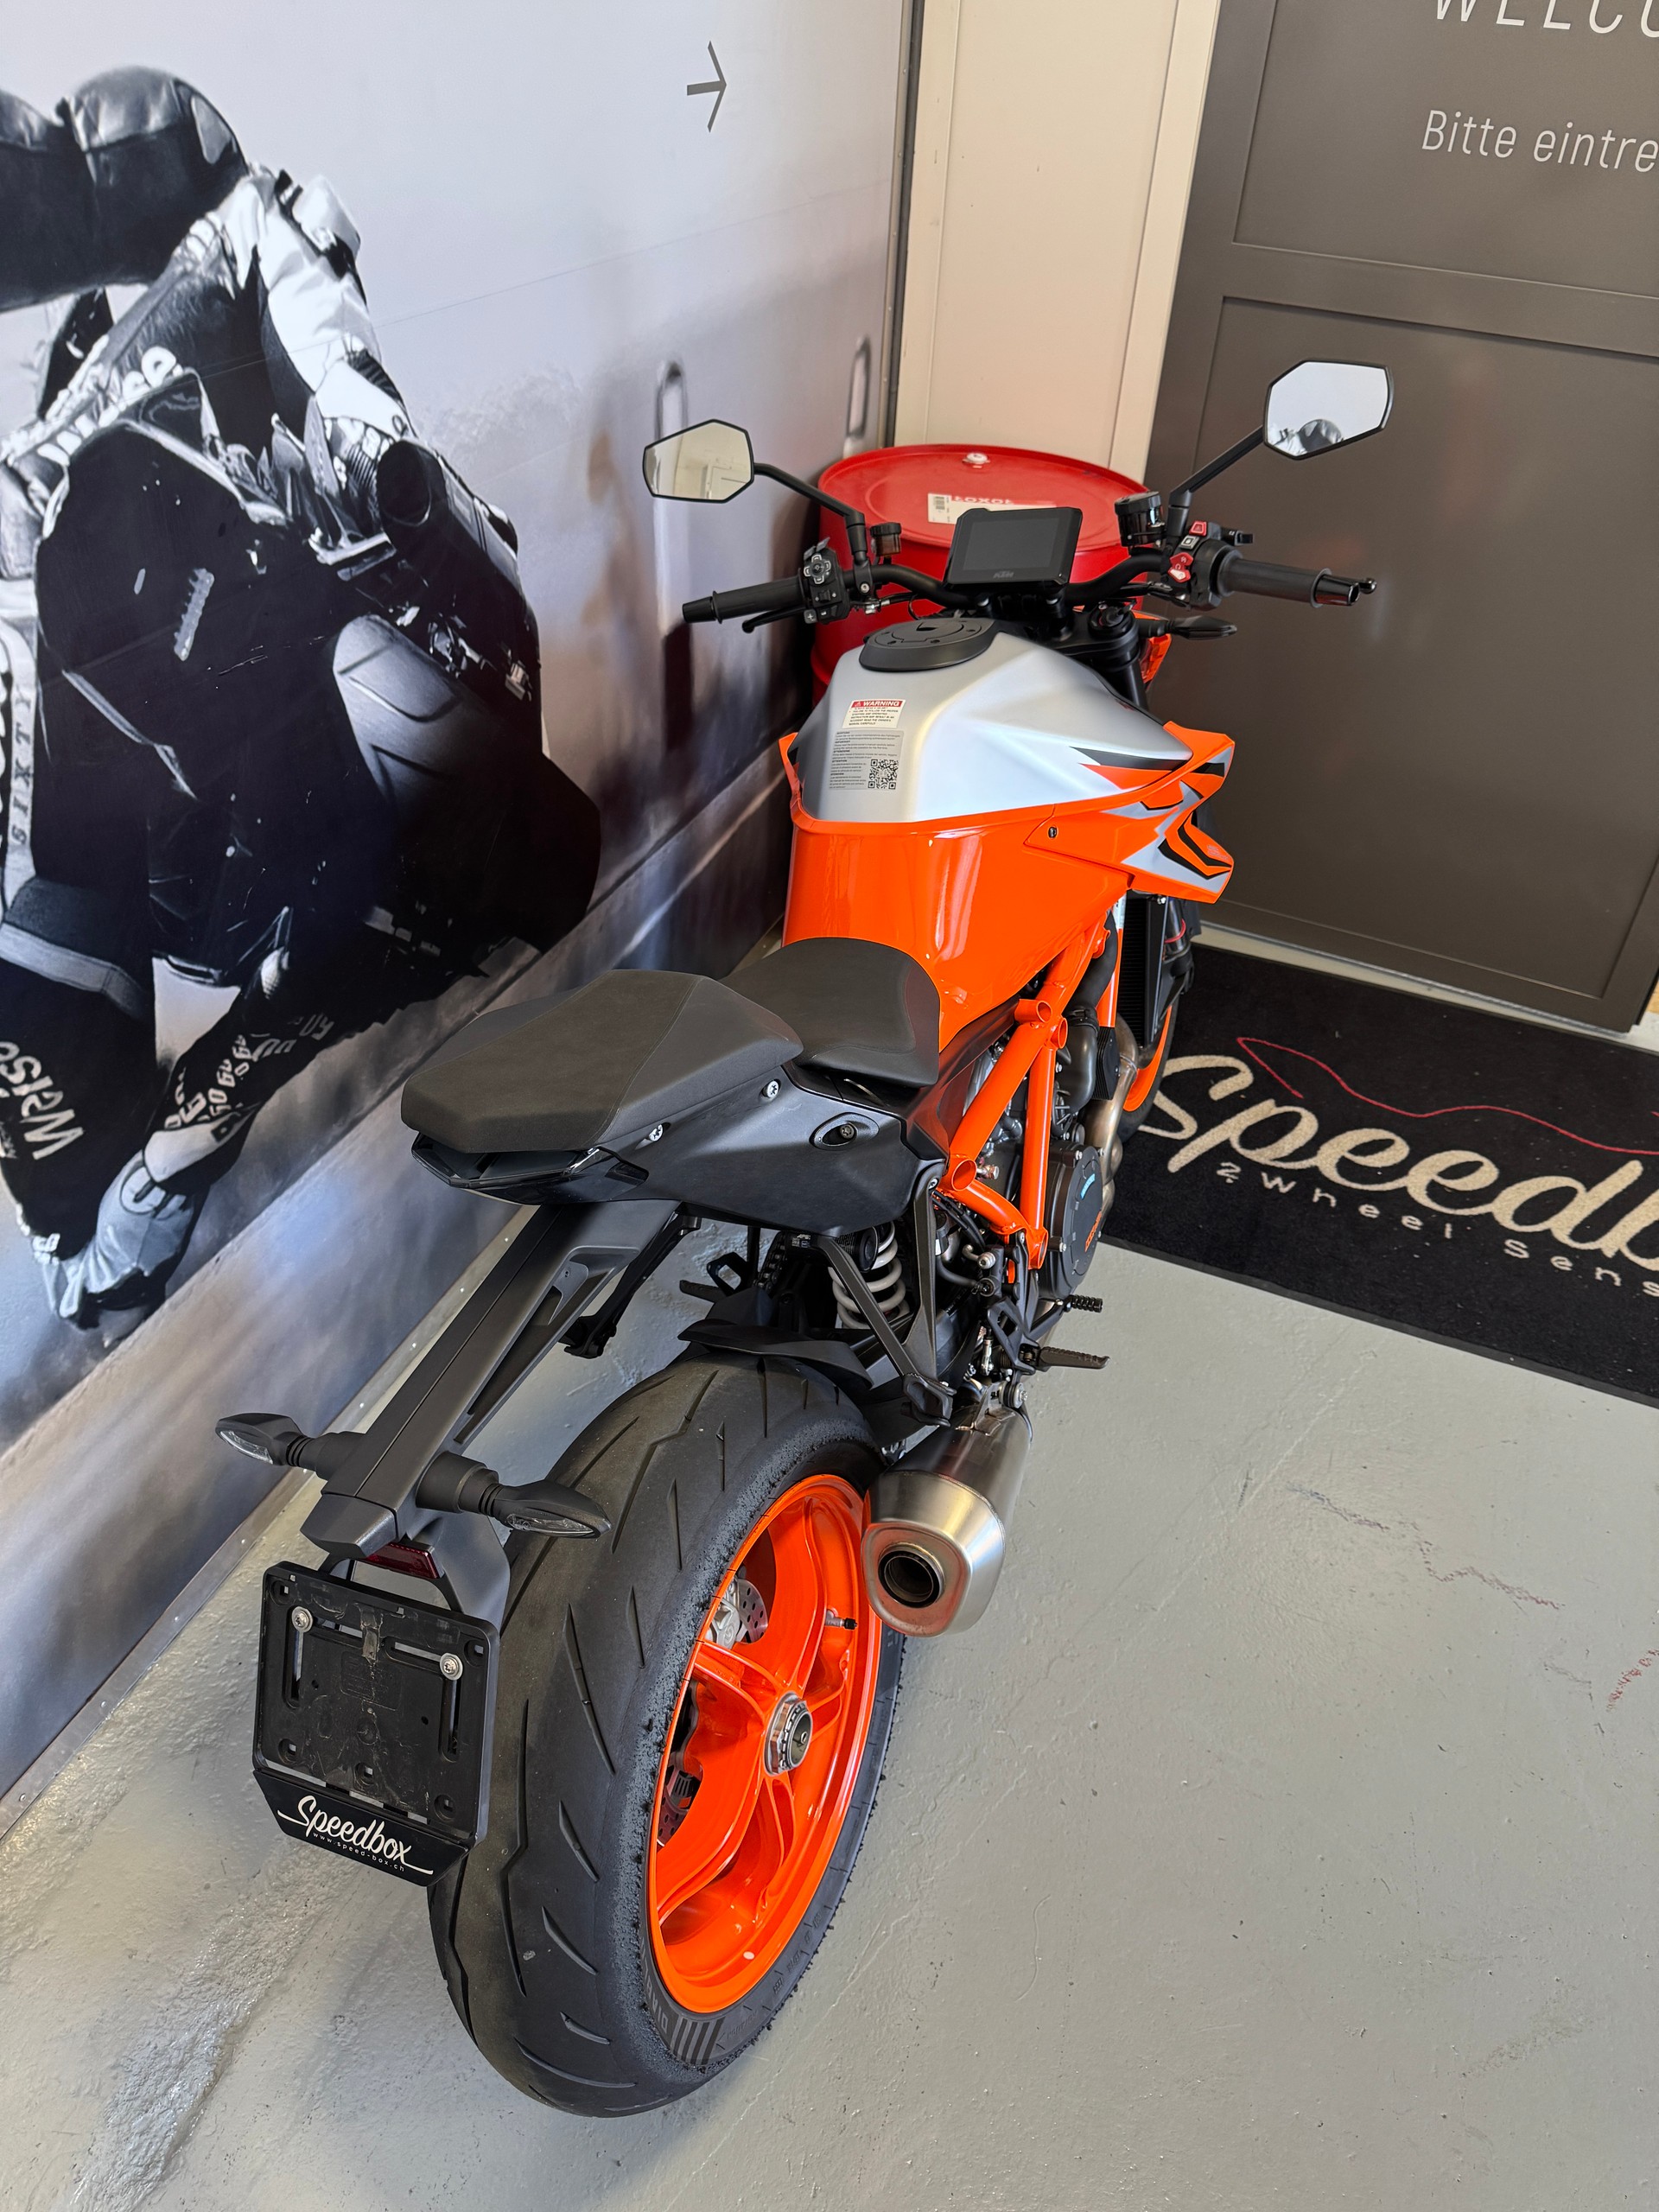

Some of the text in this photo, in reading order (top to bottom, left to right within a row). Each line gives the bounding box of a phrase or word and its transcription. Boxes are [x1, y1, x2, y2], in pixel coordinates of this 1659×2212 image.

[1421, 110, 1659, 172] Bitte eintre
[10, 687, 32, 845] SIXTY
[277, 1795, 433, 1875] Speedbox
[313, 1832, 404, 1872] www.speed-box.ch
